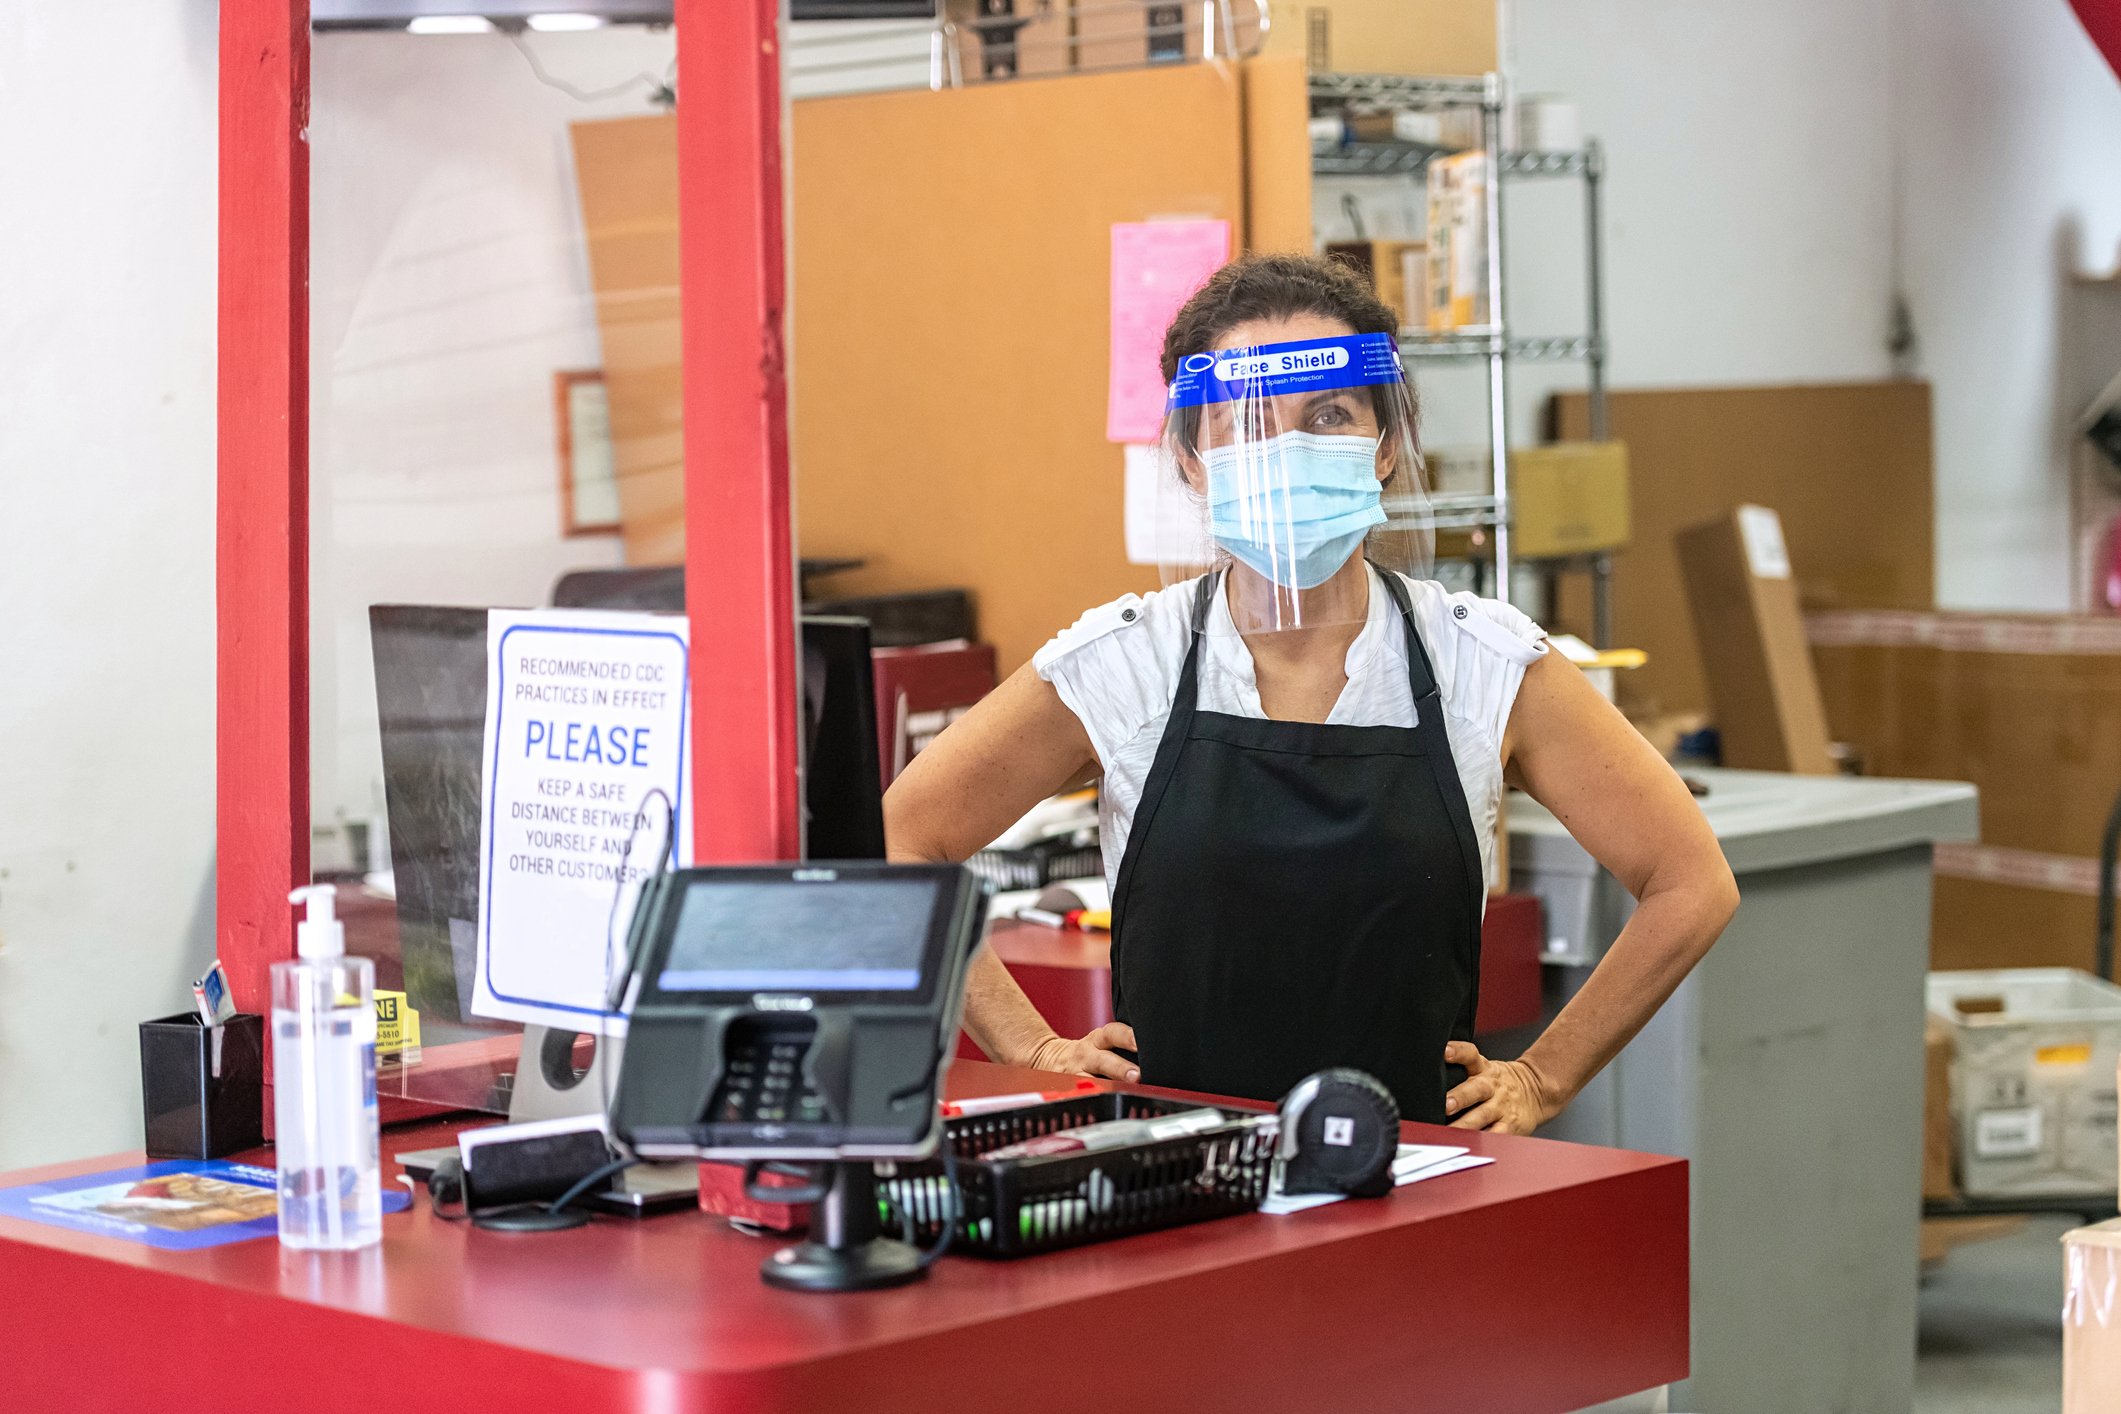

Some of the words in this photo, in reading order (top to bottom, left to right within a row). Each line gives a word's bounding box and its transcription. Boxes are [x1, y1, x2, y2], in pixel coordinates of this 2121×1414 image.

[1230, 362, 1269, 377] Face
[1281, 352, 1336, 370] Shield
[1265, 377, 1289, 387] Splash
[1290, 373, 1324, 384] Protection
[520, 657, 631, 680] RECOMMENDED
[636, 664, 664, 682] CDC
[515, 683, 588, 705] PRACTICES
[592, 689, 608, 705] IN
[612, 690, 667, 709] EFFECT
[525, 719, 651, 767] PLEASE
[537, 777, 572, 797] KEEP
[575, 781, 585, 797] A
[589, 782, 627, 802] SAFE
[511, 801, 578, 825] DISTANCE
[582, 808, 652, 831] BETWEEN
[526, 829, 597, 851] YOURSELF
[602, 837, 632, 856] AND
[509, 854, 554, 876] OTHER
